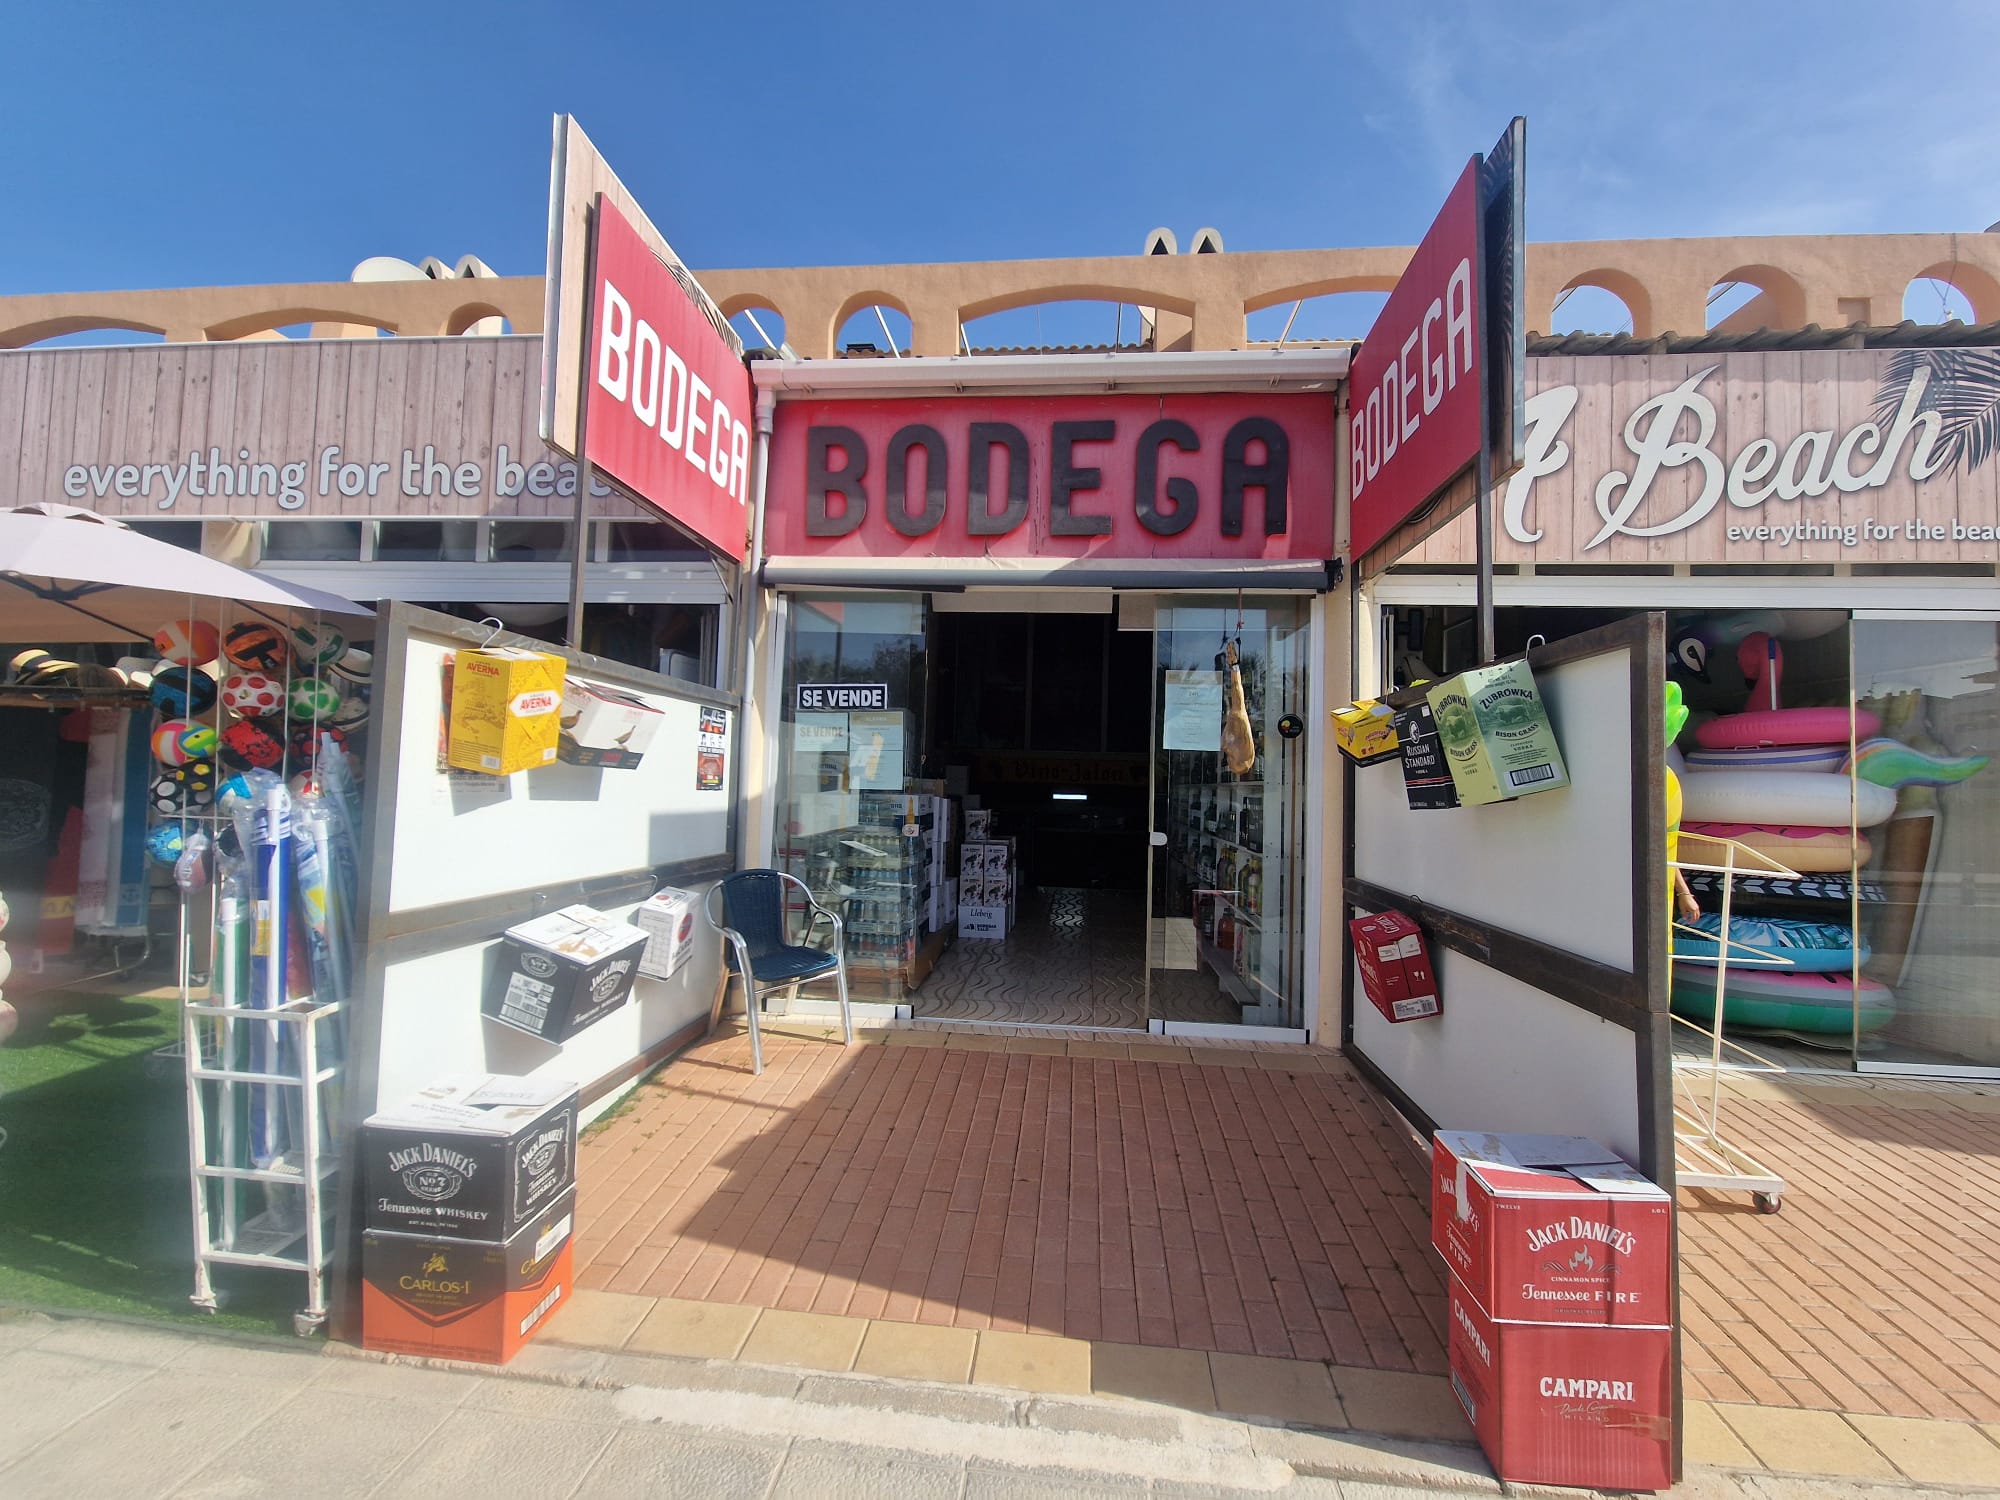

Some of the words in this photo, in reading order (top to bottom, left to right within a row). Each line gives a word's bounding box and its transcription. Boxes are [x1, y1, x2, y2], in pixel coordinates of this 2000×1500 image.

[598, 279, 749, 506] BODEGA
[1352, 257, 1474, 501] BODEGA
[1584, 364, 1958, 551] Beach
[64, 447, 307, 510] everything
[318, 445, 391, 497] for
[401, 445, 482, 497] the
[806, 416, 1289, 537] BODEGA
[1727, 519, 1857, 547] everything
[1863, 518, 1899, 541] for
[1905, 519, 1945, 541] the
[466, 662, 500, 677] AVERNA
[520, 696, 552, 710] AVERNA
[802, 689, 823, 707] SE
[827, 689, 883, 707] VENDE
[1405, 755, 1435, 769] STANDARD
[1406, 743, 1430, 757] RUSSIAN
[388, 1146, 421, 1172] JACK
[422, 1142, 477, 1178] DANIEL'S
[520, 1142, 538, 1168] JACK
[526, 1177, 557, 1206] WHISKEY
[378, 1198, 432, 1215] Tennessee
[435, 1206, 489, 1220] WHISKEY
[1525, 1221, 1569, 1252] JACK
[1570, 1216, 1636, 1255] DANIEL'S
[1521, 1283, 1590, 1301] Tennessee
[1594, 1290, 1641, 1304] FIRE
[1551, 1276, 1590, 1284] CINNAMON
[1454, 1298, 1490, 1367] CAMPARI
[1540, 1376, 1633, 1401] CAMPARI
